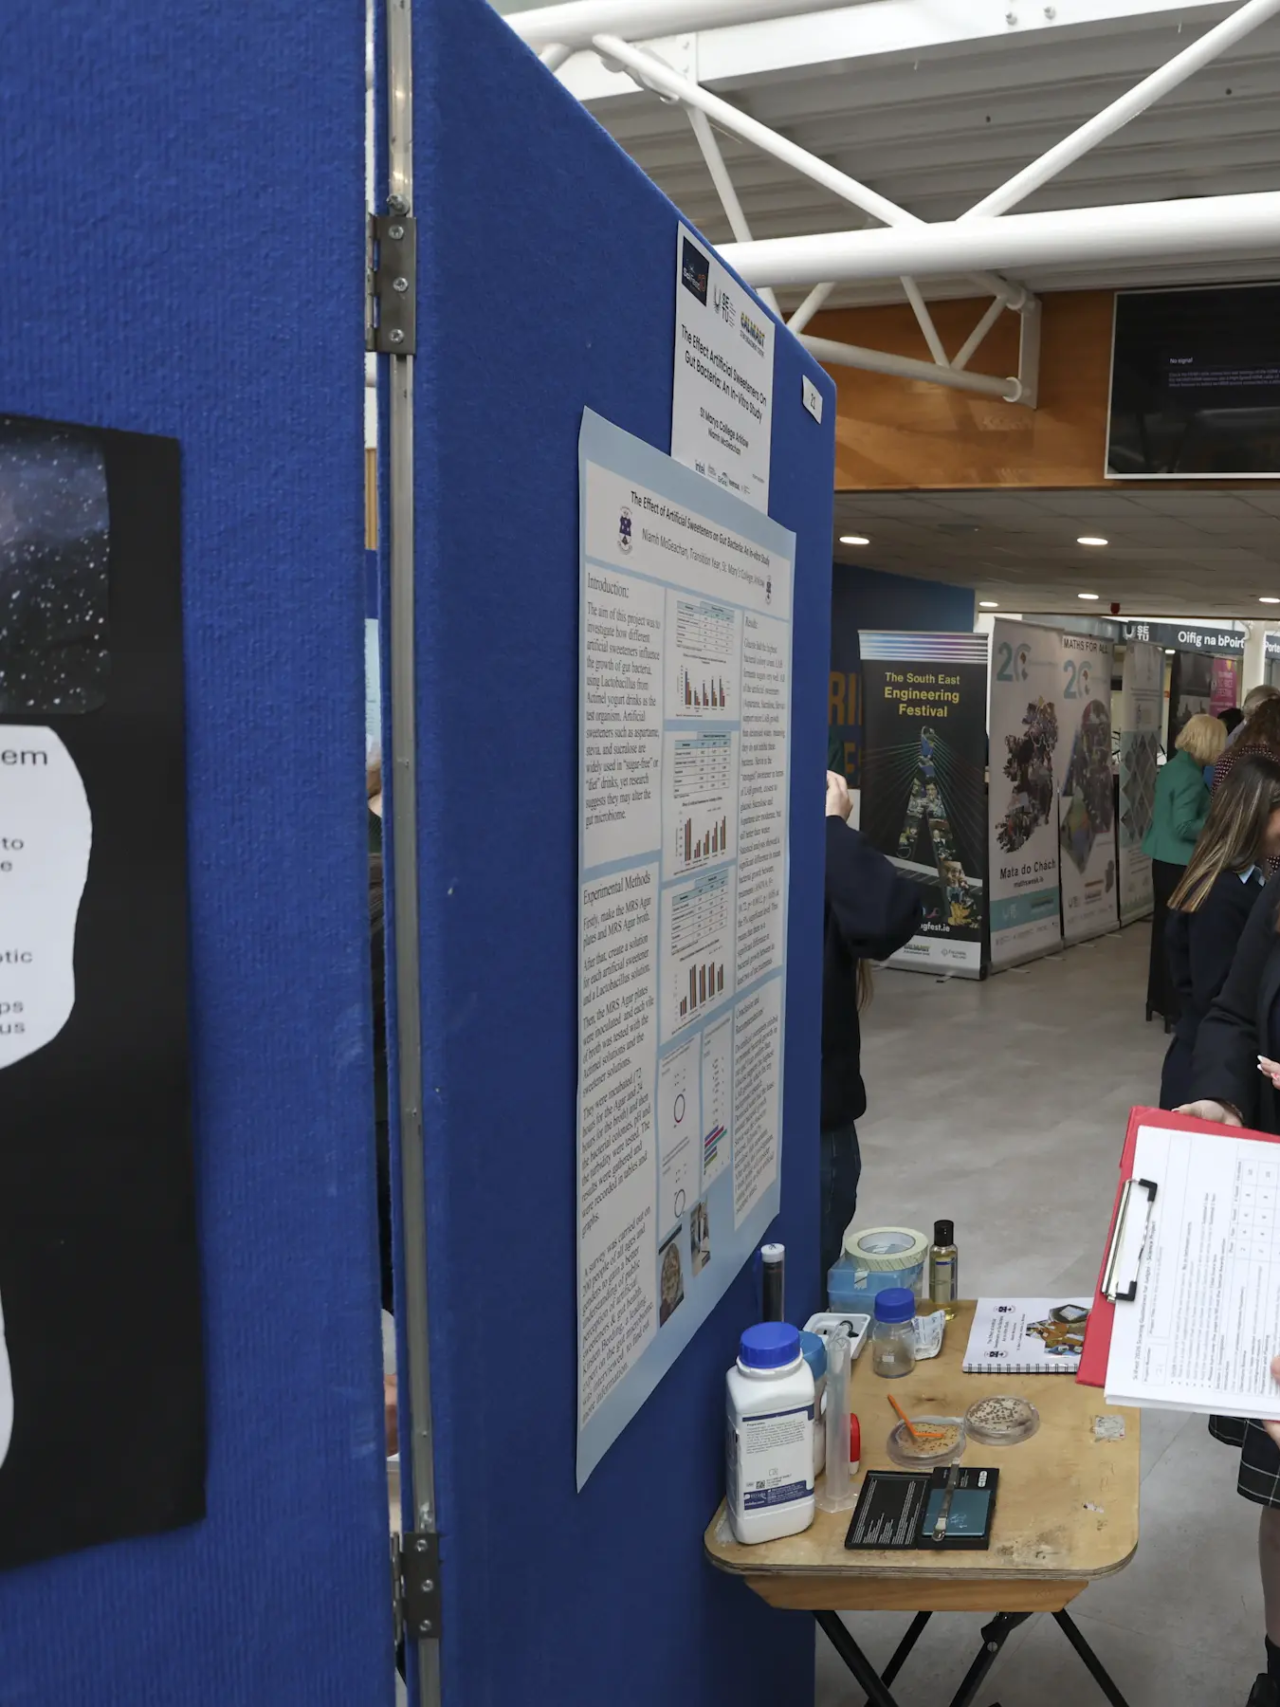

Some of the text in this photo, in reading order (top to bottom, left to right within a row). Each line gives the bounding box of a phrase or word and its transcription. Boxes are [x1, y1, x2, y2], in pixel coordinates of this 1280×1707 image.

[682, 324, 766, 407] The Effect Artificial Sweeteners On
[685, 350, 696, 370] Gut
[722, 380, 730, 396] An
[750, 402, 762, 424] Study
[720, 421, 735, 440] College
[631, 491, 642, 508] The
[644, 496, 660, 516] Effect
[660, 506, 666, 518] of
[666, 508, 687, 527] Artificial
[688, 517, 712, 540] Sweeteners
[712, 530, 719, 542] on
[642, 528, 660, 546] Niamh
[690, 548, 711, 568] Transition
[588, 573, 630, 598] Introduction:
[588, 602, 598, 616] The
[599, 606, 608, 618] aim
[610, 607, 616, 620] of
[616, 610, 626, 622] this
[628, 613, 646, 627] project
[588, 619, 614, 638] investigate
[628, 629, 650, 644] different
[1178, 630, 1202, 648] Oifig
[1204, 635, 1217, 646] na
[587, 638, 660, 661] artificial sweeteners influence
[1063, 638, 1110, 654] MATHS FOR ALL
[596, 658, 614, 672] growth
[615, 660, 620, 672] of
[601, 674, 636, 690] Lactobacillus
[885, 672, 960, 685] The South East
[884, 686, 960, 704] Engineering
[899, 704, 948, 718] Festival
[1000, 867, 1018, 880] Mata
[1022, 864, 1032, 875] do
[584, 870, 651, 906] Experimental Methods
[1148, 1220, 1156, 1240] Project
[1145, 1240, 1154, 1261] Science
[1143, 1266, 1151, 1284] Judges
[1136, 1324, 1144, 1345] Scoring
